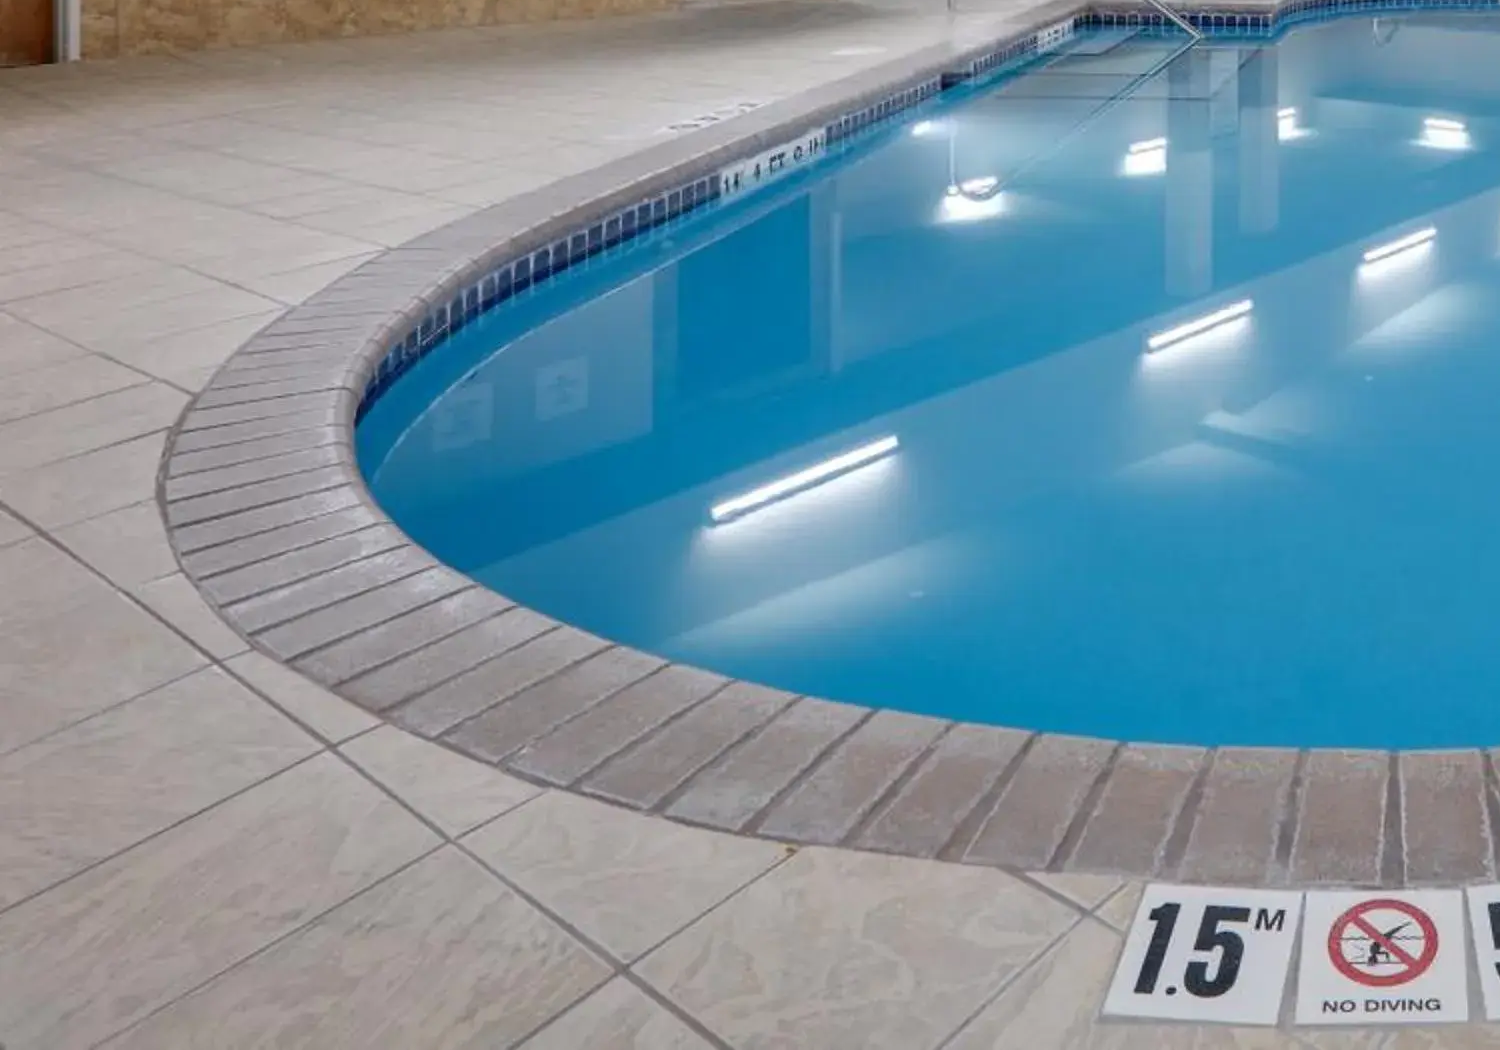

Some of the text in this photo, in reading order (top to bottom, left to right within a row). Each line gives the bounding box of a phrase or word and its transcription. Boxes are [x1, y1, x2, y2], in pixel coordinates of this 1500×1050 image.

[1133, 902, 1286, 998] 1.5 M
[1321, 998, 1442, 1013] NO DIVING
